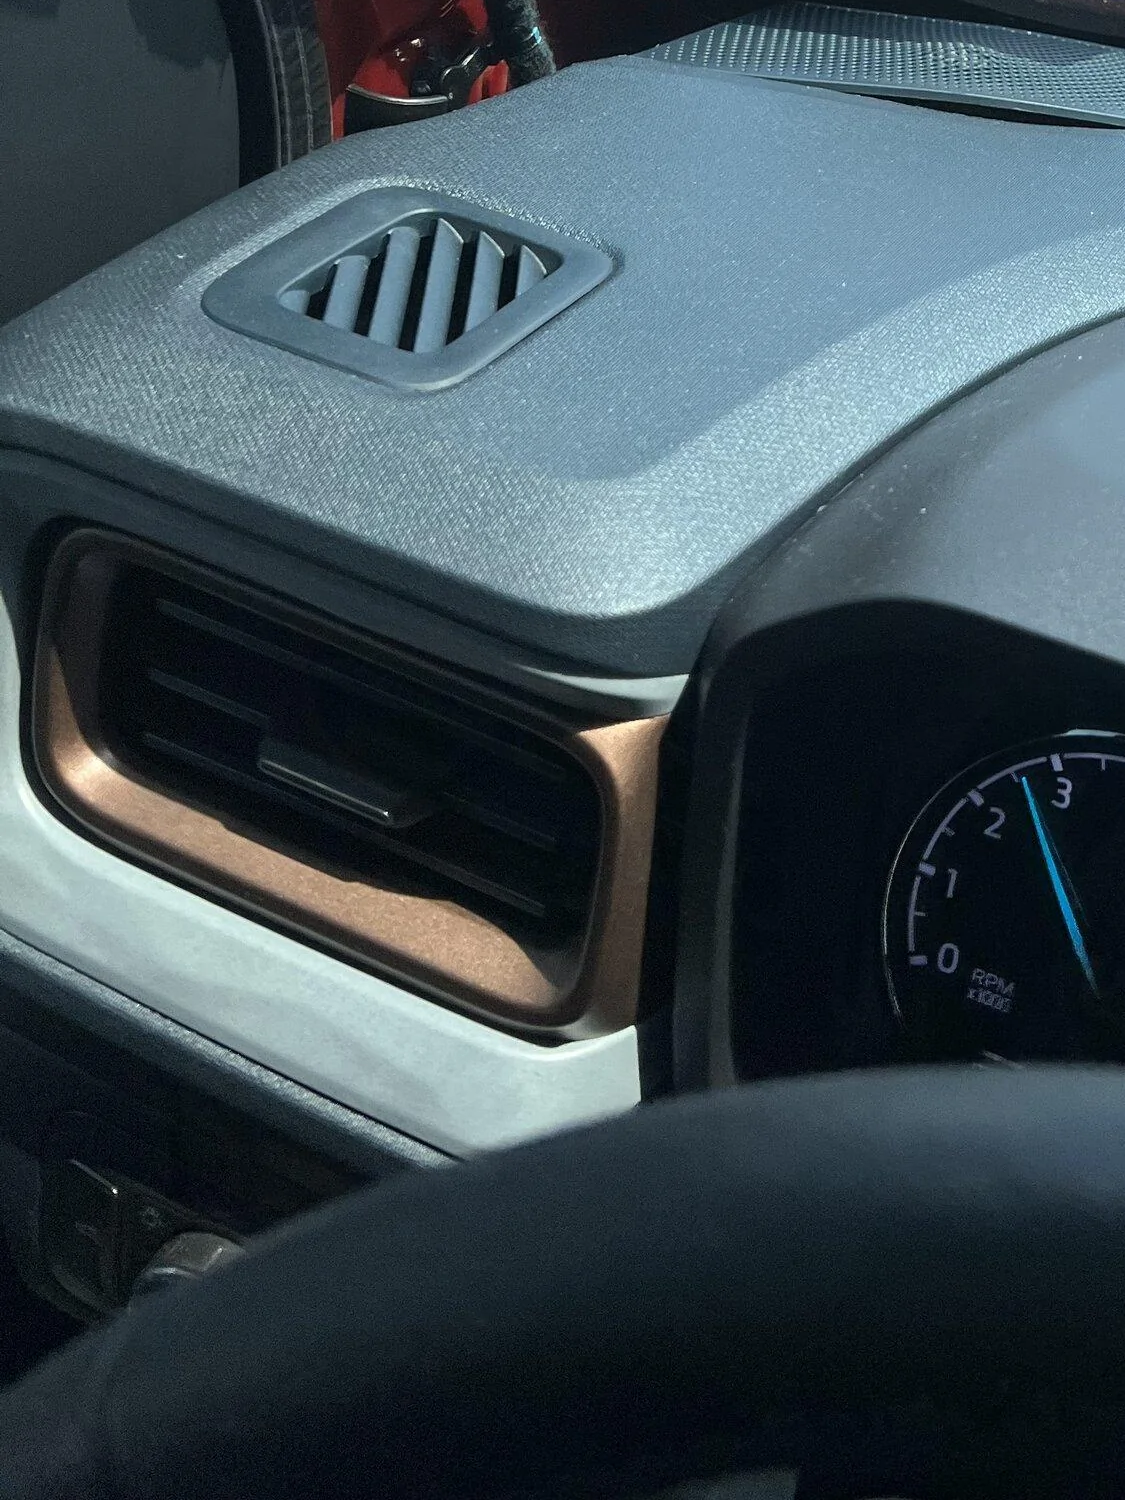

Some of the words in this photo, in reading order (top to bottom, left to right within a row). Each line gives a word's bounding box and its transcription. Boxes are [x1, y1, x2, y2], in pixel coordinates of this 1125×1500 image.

[1051, 776, 1073, 809] 3
[983, 806, 1006, 840] 2
[946, 868, 959, 898] 1
[937, 943, 960, 974] 0
[972, 968, 1016, 998] RPM
